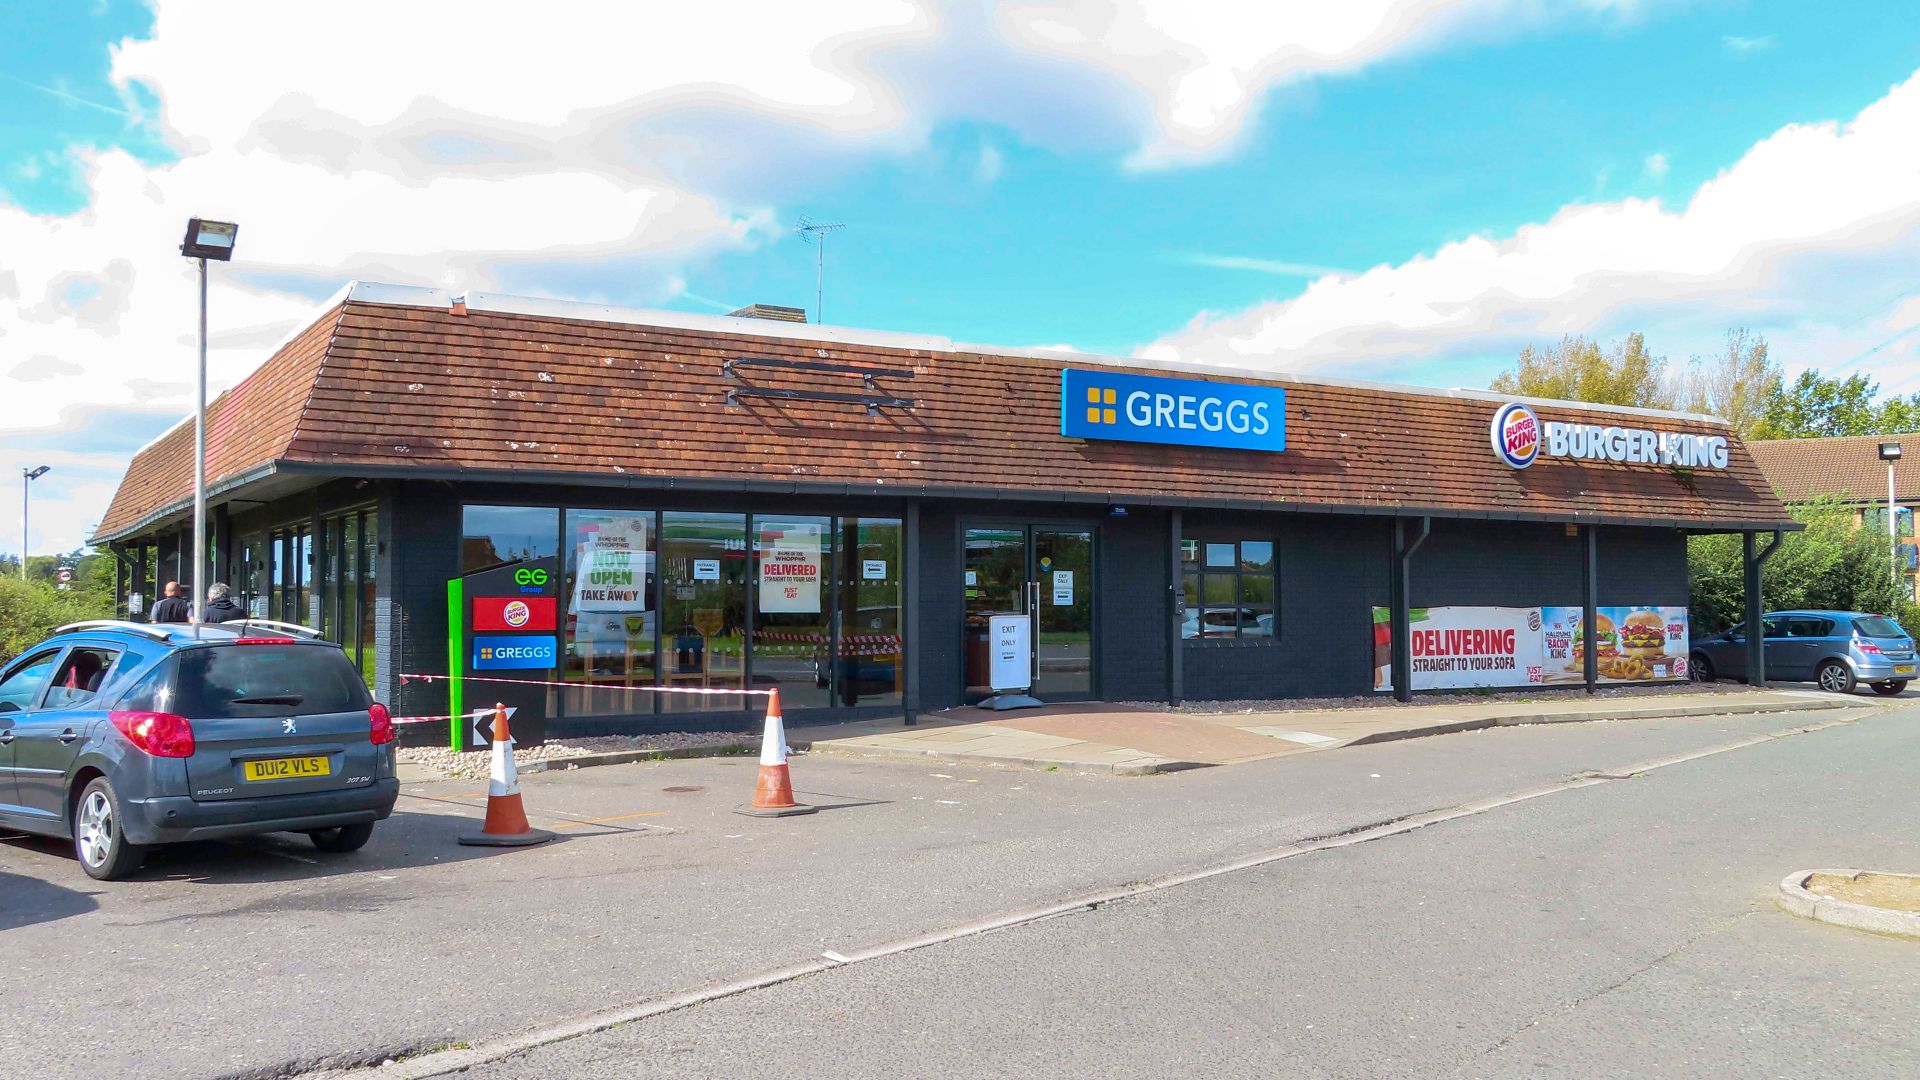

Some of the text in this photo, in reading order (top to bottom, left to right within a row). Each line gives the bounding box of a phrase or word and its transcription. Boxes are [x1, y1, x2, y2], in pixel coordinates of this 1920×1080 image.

[1126, 390, 1270, 435] GREGGS
[1505, 417, 1535, 438] BURGER
[1507, 428, 1537, 454] KING
[1545, 422, 1728, 469] BURGER KING
[591, 552, 631, 568] NOW
[764, 564, 817, 576] DELIVERED
[590, 569, 633, 585] OPEN
[520, 585, 543, 594] Group
[581, 590, 606, 601] TAKE
[507, 606, 526, 615] BURGER
[508, 611, 527, 620] KING
[1001, 625, 1017, 634] EXIT
[1667, 624, 1684, 633] BACON
[1412, 629, 1515, 657] DELIVERING
[495, 646, 551, 659] GREGGS
[1550, 648, 1567, 659] KING
[1412, 656, 1515, 672] STRAIGHT TO YOUR SOFA
[1526, 666, 1542, 676] JUST
[1529, 675, 1542, 683] EAT
[255, 759, 320, 777] DU12 VLS
[197, 788, 234, 796] PEUGEOT
